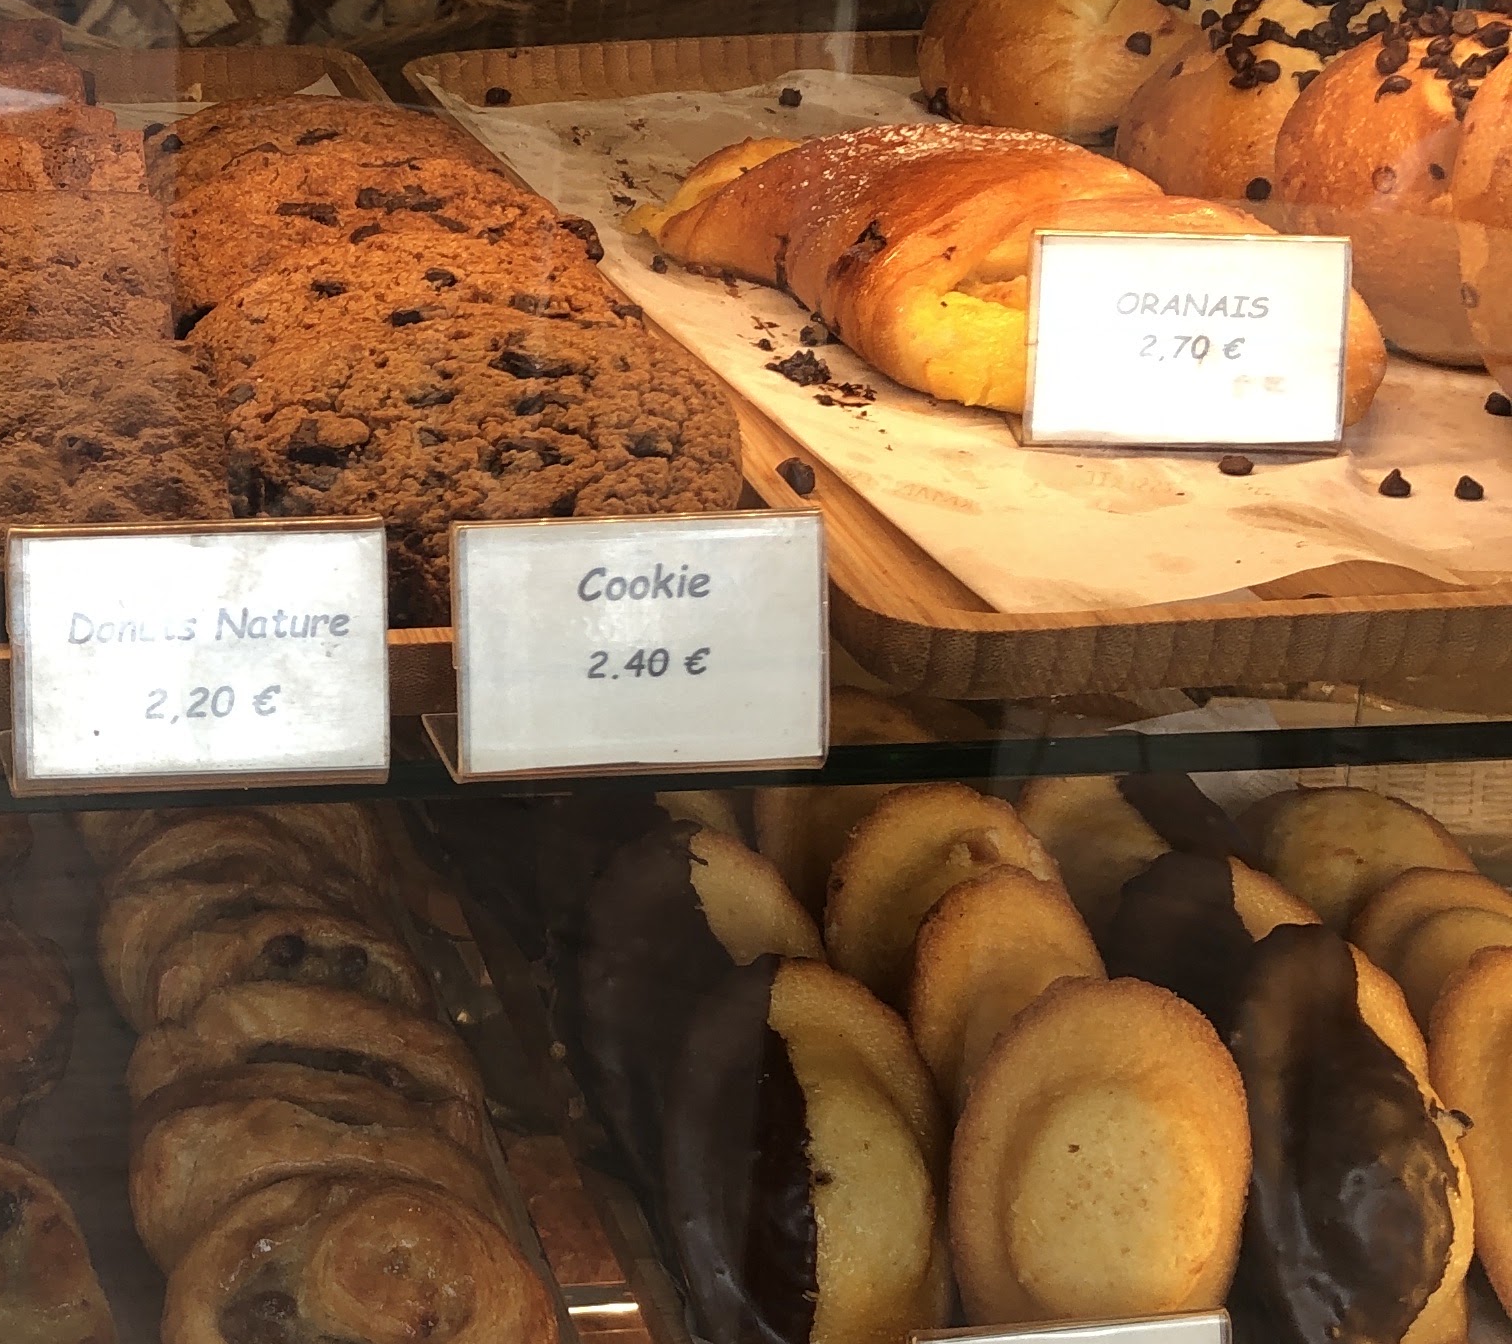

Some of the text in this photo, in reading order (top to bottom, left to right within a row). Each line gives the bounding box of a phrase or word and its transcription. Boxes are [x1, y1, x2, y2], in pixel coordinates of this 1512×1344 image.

[1117, 292, 1270, 319] ORANAIS
[1139, 335, 1245, 362] 2,70 €
[578, 563, 711, 602] Cookie
[215, 608, 350, 641] Nature
[588, 648, 711, 680] 2.40 €
[145, 684, 281, 724] 2,20 €
